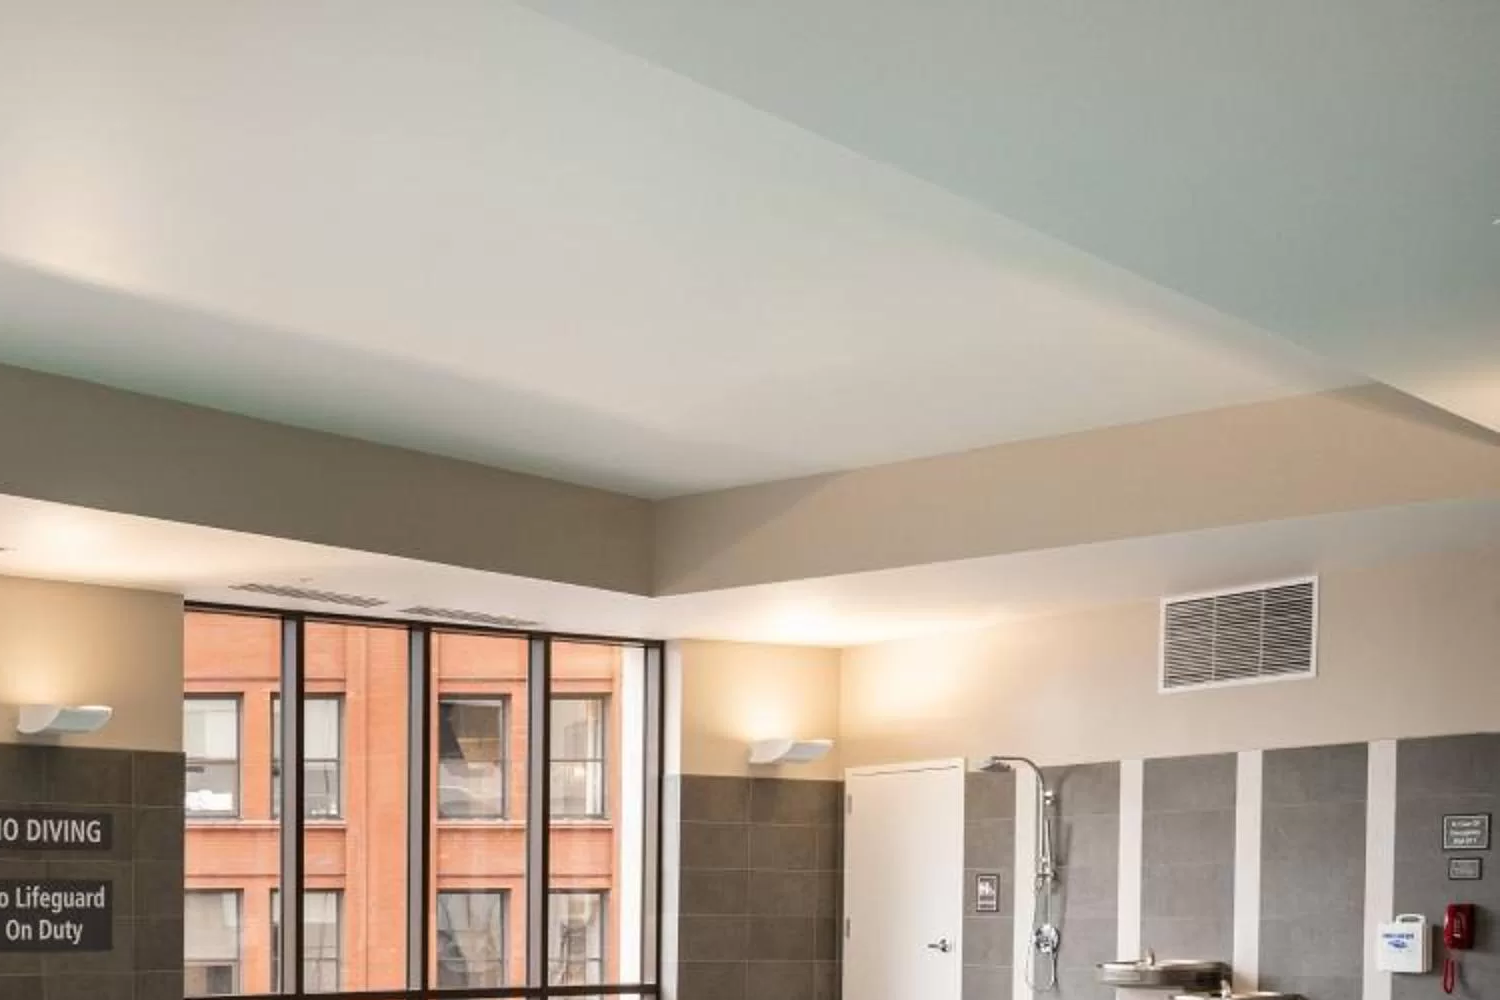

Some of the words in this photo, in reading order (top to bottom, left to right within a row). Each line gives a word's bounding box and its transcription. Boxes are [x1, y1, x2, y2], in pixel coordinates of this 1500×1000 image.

[26, 819, 101, 843] DIVING
[15, 885, 105, 913] Lifeguard
[5, 919, 33, 941] On
[39, 919, 83, 944] Duty
